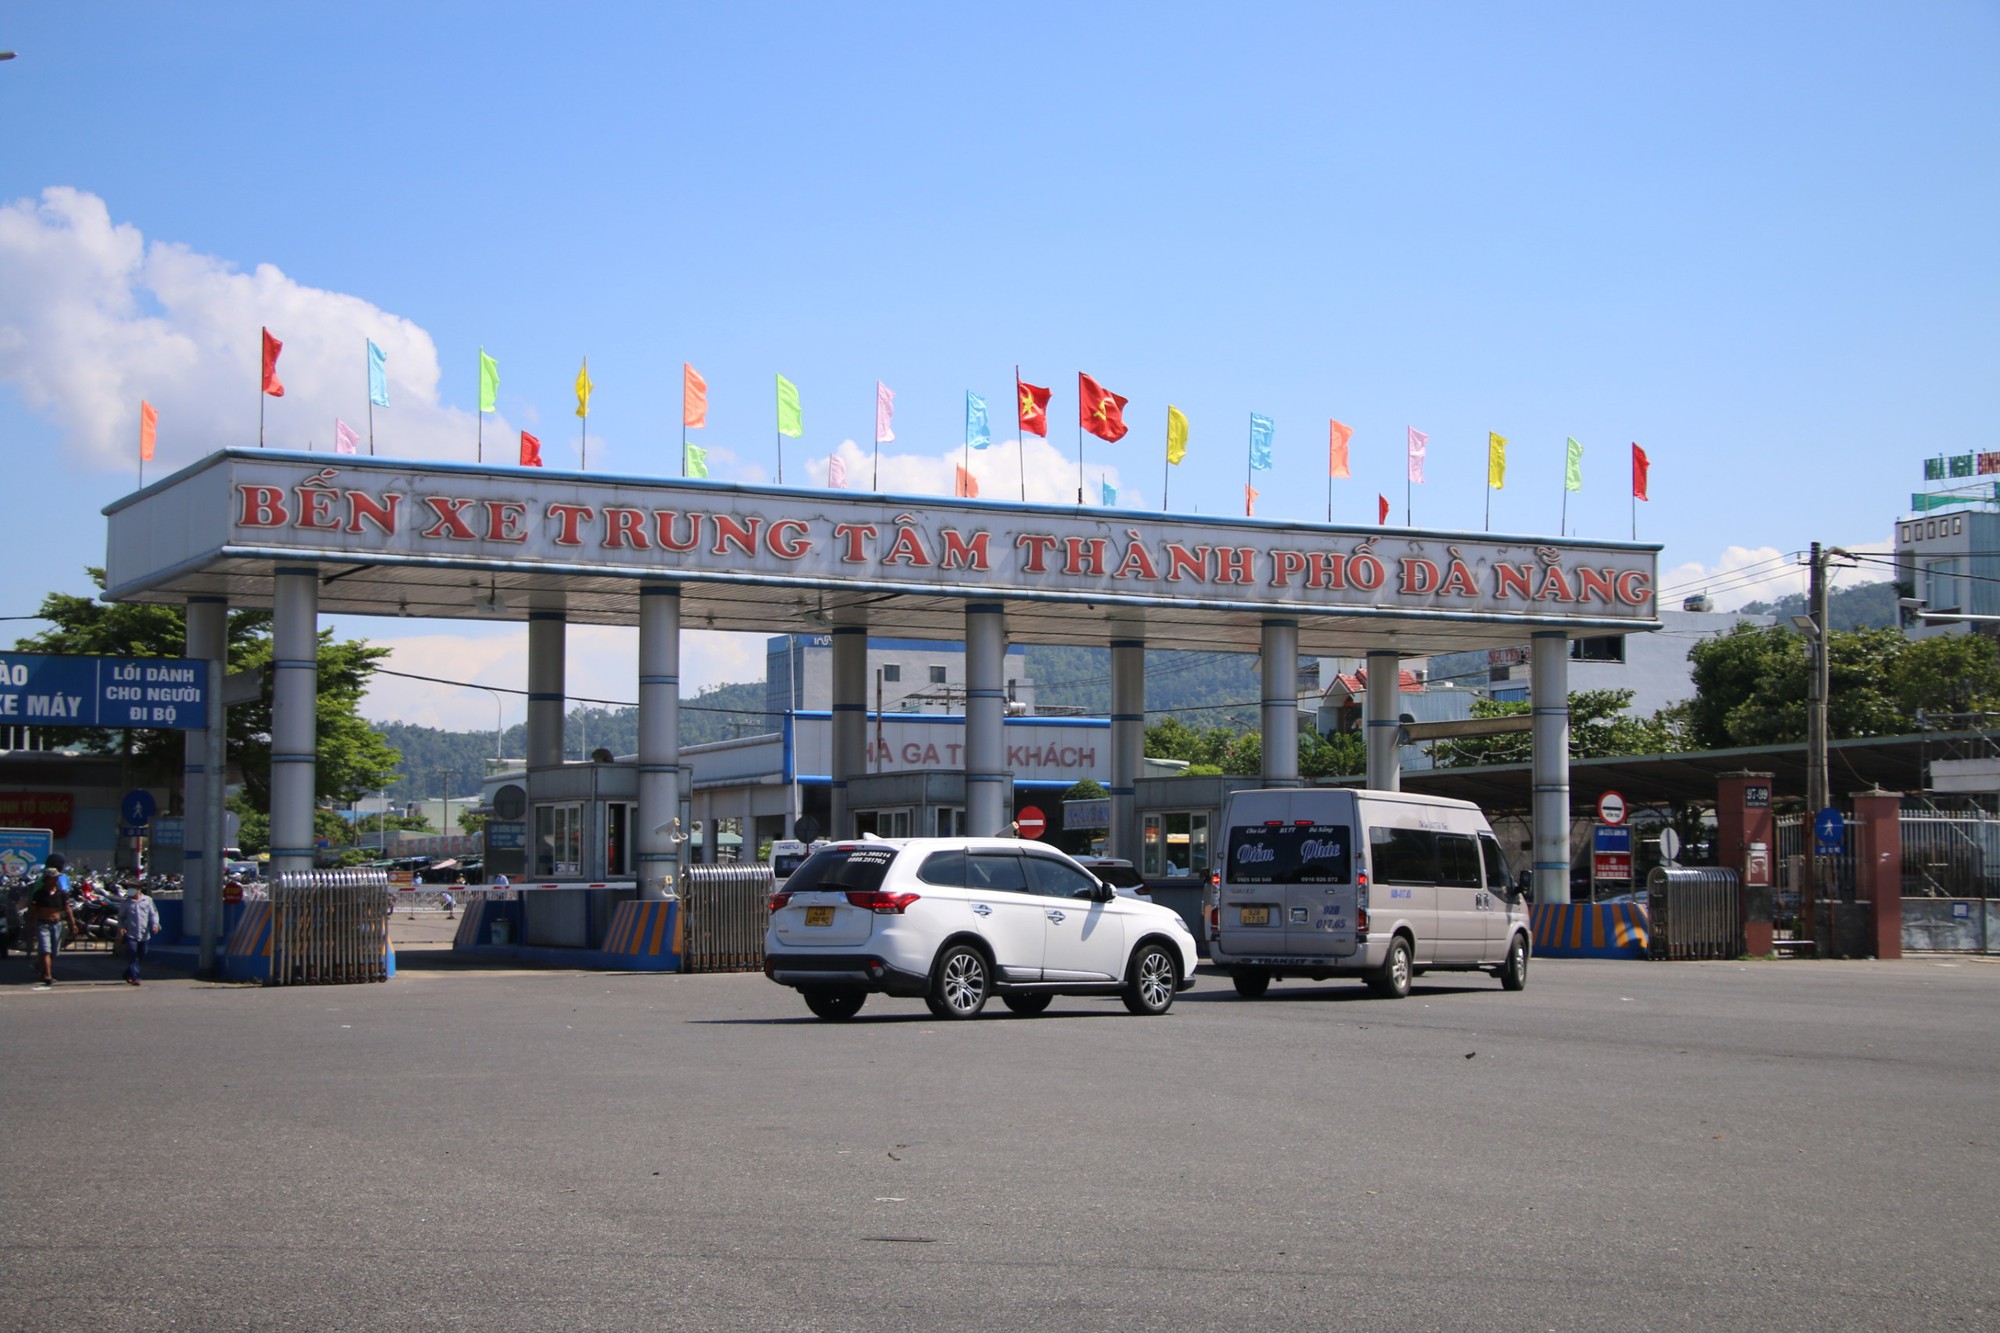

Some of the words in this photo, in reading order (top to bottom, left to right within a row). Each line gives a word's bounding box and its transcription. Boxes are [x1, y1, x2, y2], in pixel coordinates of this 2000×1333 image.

[237, 468, 402, 535] BẾN
[421, 497, 530, 543] XE
[547, 503, 813, 560] TRUNG
[834, 513, 992, 571] TÂM
[1016, 529, 1257, 585] THÀNH
[1269, 537, 1386, 591] PHỐ
[1399, 546, 1480, 597] ĐÀ
[1492, 547, 1654, 606] NẴNG
[114, 663, 141, 681] LỐI
[146, 665, 195, 683] DÀNH
[106, 686, 142, 701] CHO
[147, 685, 200, 702] NGƯỜI
[27, 692, 82, 717] MÁY
[130, 706, 148, 721] ĐI
[153, 706, 177, 724] BỘ
[902, 742, 940, 765] GA
[1008, 741, 1096, 767] KHÁCH
[1747, 788, 1768, 800] 97-99
